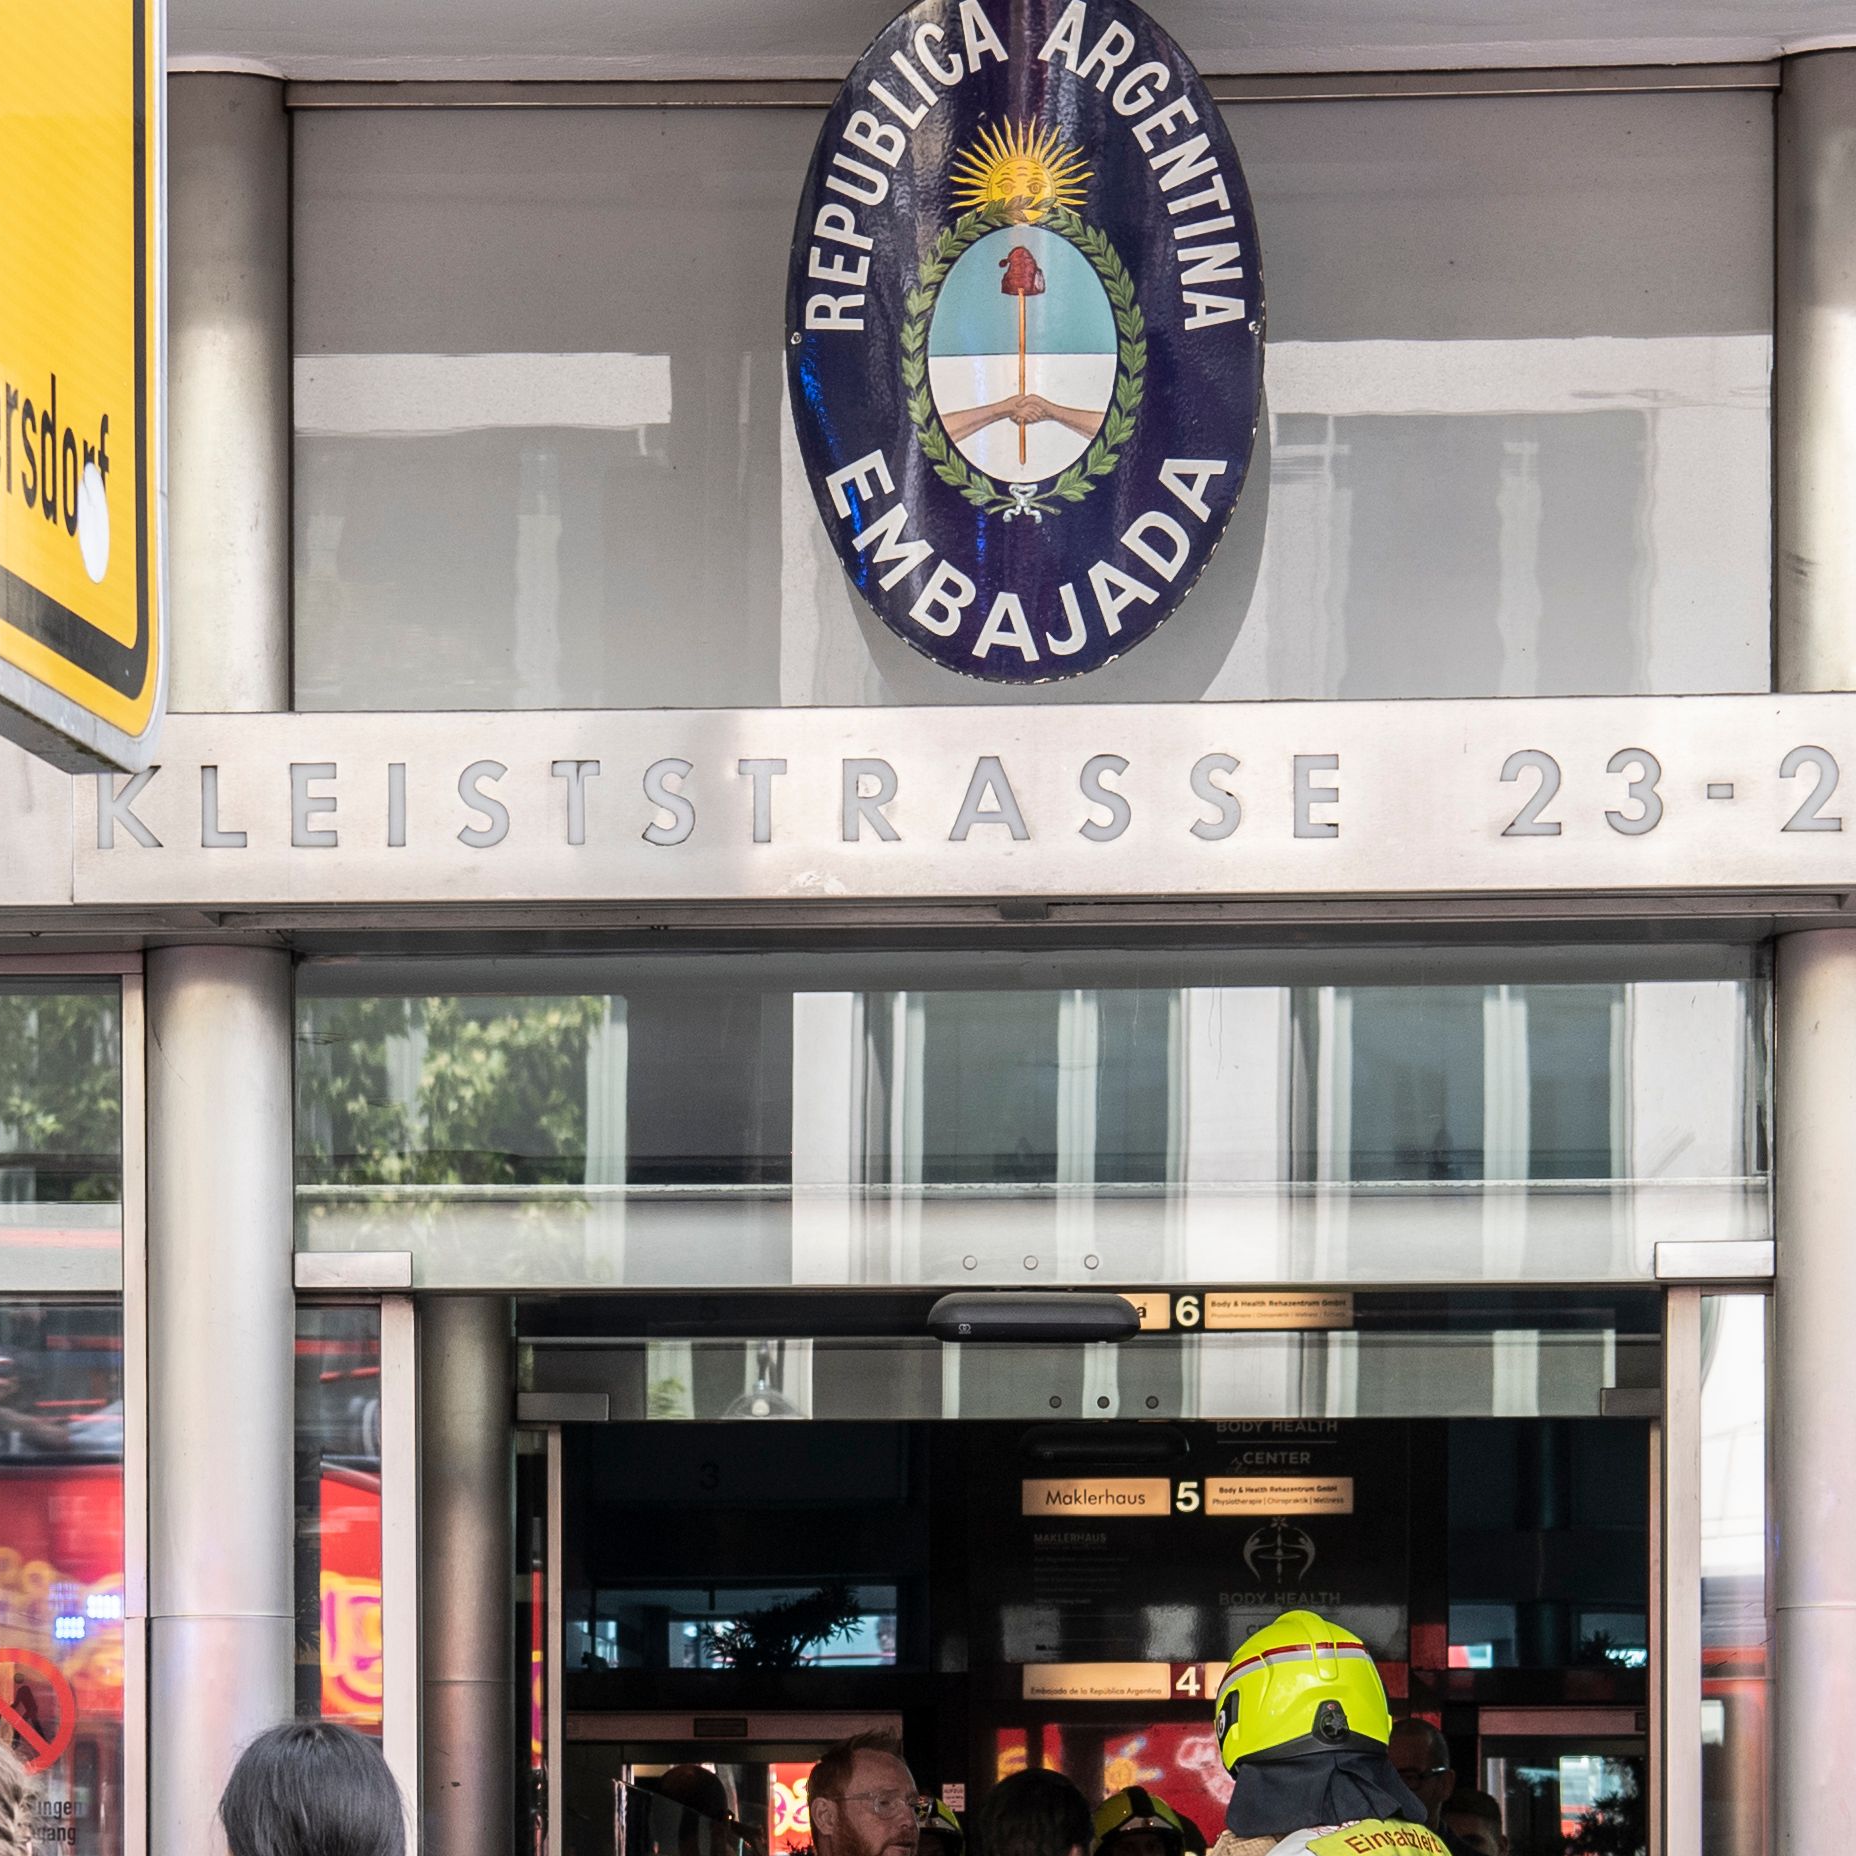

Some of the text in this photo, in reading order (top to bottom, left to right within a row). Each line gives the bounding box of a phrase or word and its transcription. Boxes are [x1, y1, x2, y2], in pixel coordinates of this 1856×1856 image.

[805, 0, 1246, 331] REPUBLICA ARGENTINA
[826, 449, 1229, 663] EMBAJADA
[97, 757, 1341, 850] KLEISTSTRASSE
[1176, 1295, 1200, 1327] 6
[1045, 1487, 1146, 1507] Maklerhaus
[1176, 1481, 1200, 1513] 5
[1175, 1666, 1200, 1697] 4
